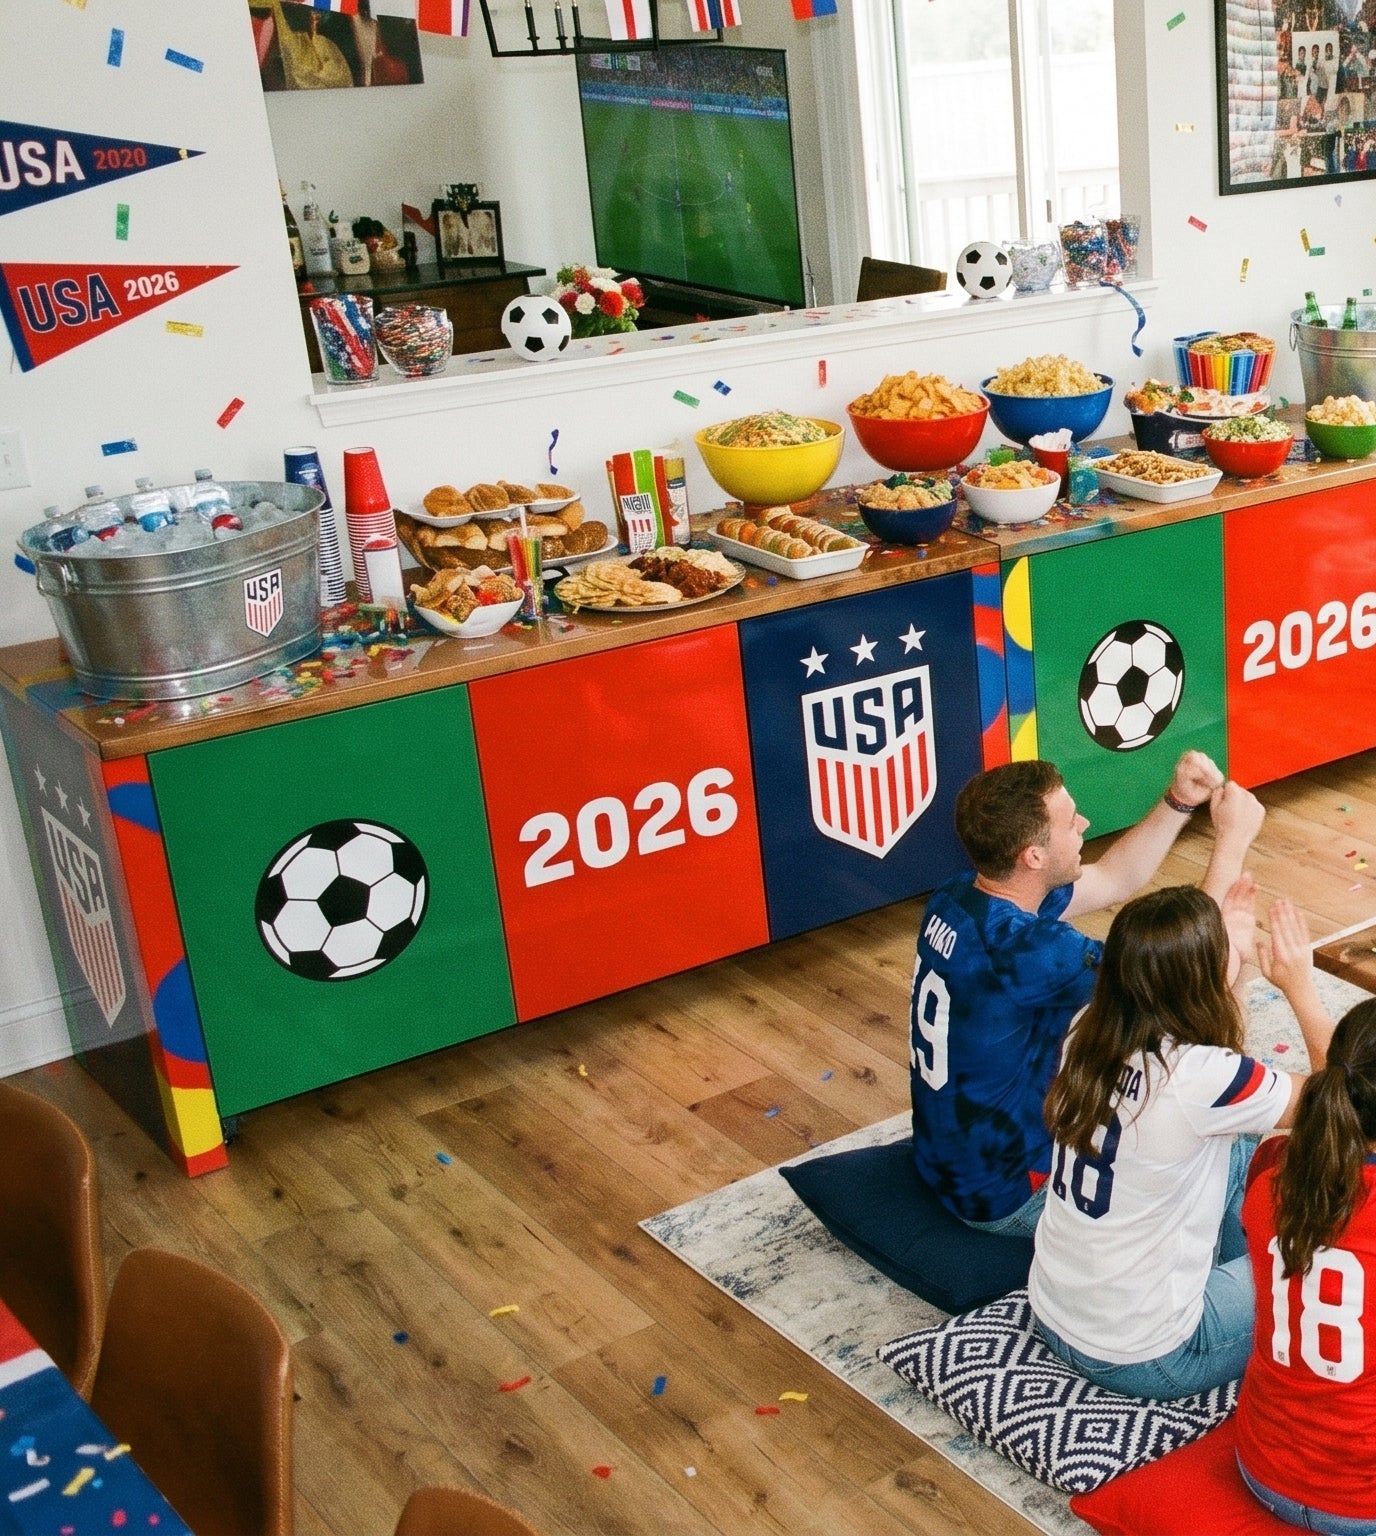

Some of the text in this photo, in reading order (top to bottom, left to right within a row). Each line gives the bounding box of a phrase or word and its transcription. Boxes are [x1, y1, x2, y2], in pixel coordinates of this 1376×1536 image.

[0, 140, 147, 191] USA 2020
[17, 271, 179, 334] USA 2026
[247, 573, 279, 602] USA
[812, 677, 924, 756] USA
[519, 767, 738, 888] 2026
[909, 953, 950, 1091] 9
[1267, 1235, 1365, 1384] 18
